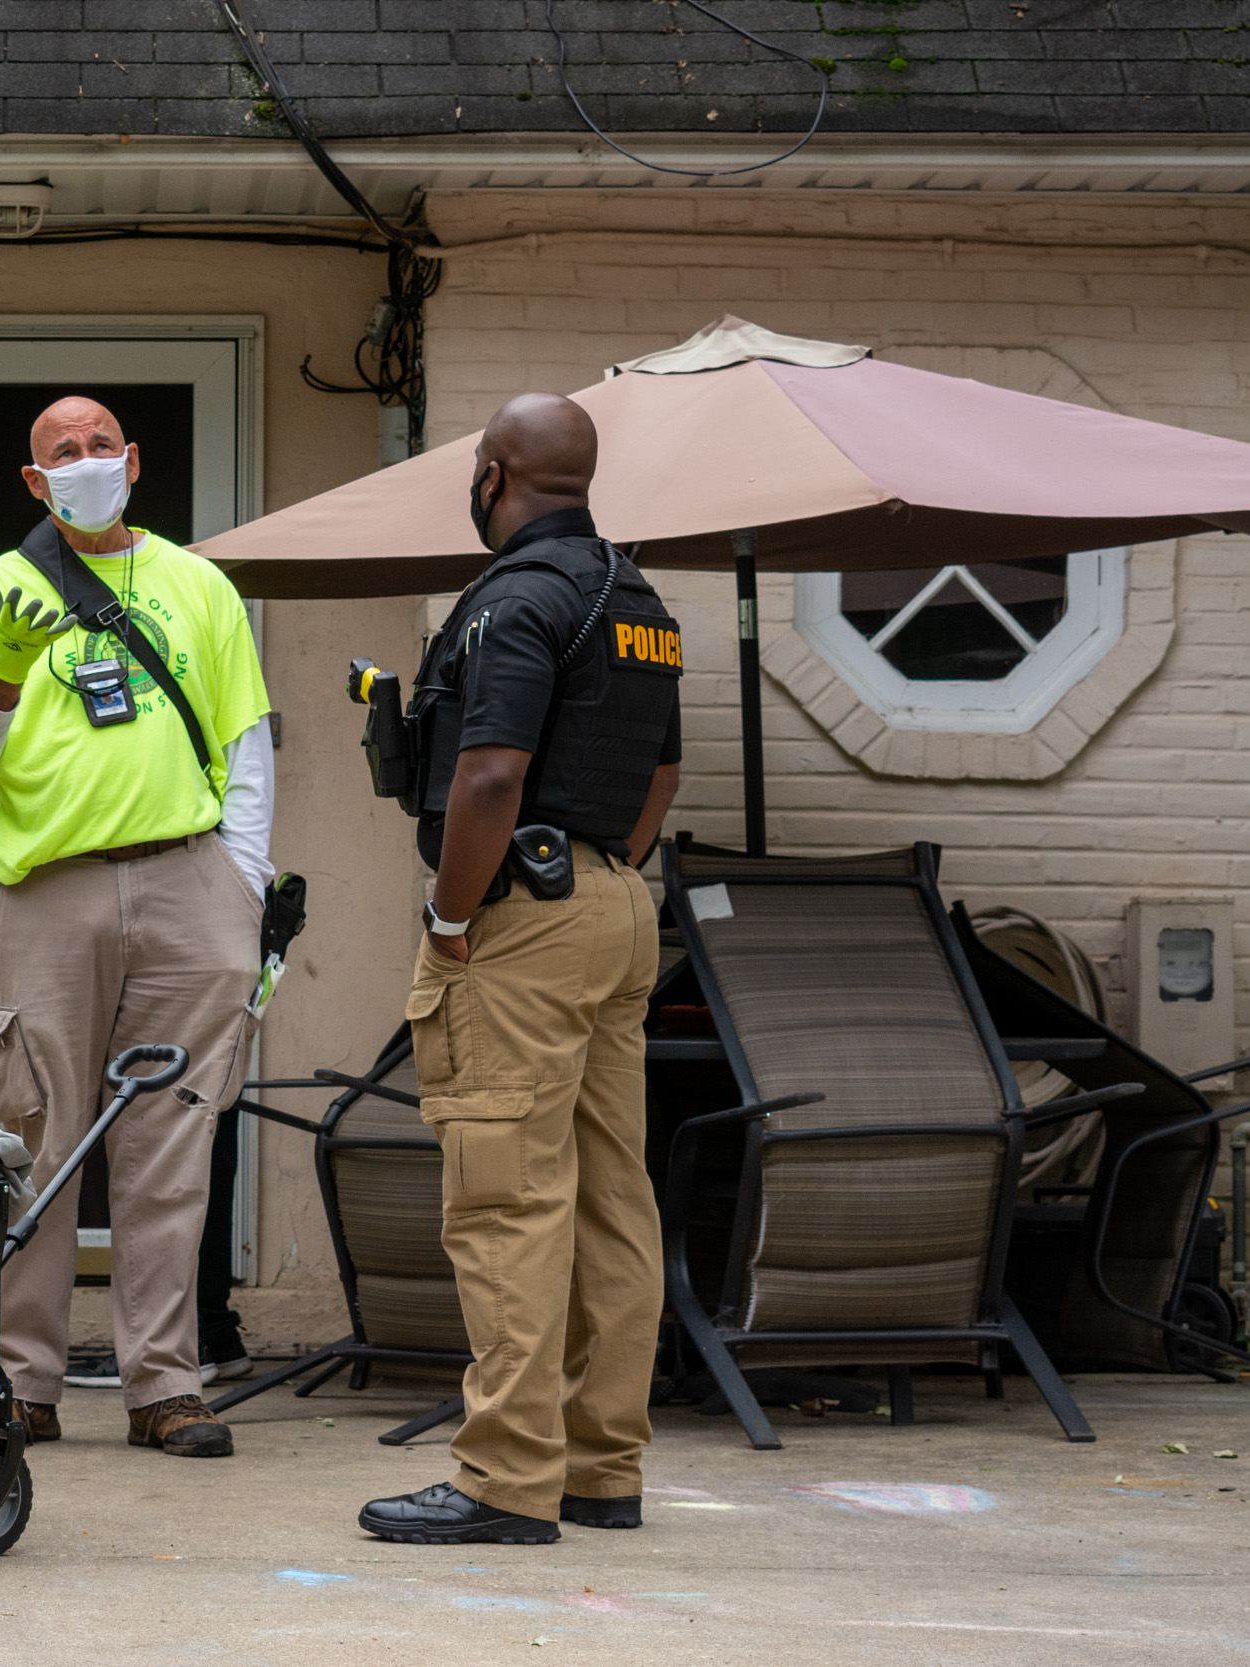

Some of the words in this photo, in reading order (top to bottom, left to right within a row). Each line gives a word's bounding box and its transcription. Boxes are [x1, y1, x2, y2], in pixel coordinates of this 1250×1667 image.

[149, 598, 173, 621] ON
[139, 612, 167, 660] WILMINGT
[615, 623, 682, 668] POLICE
